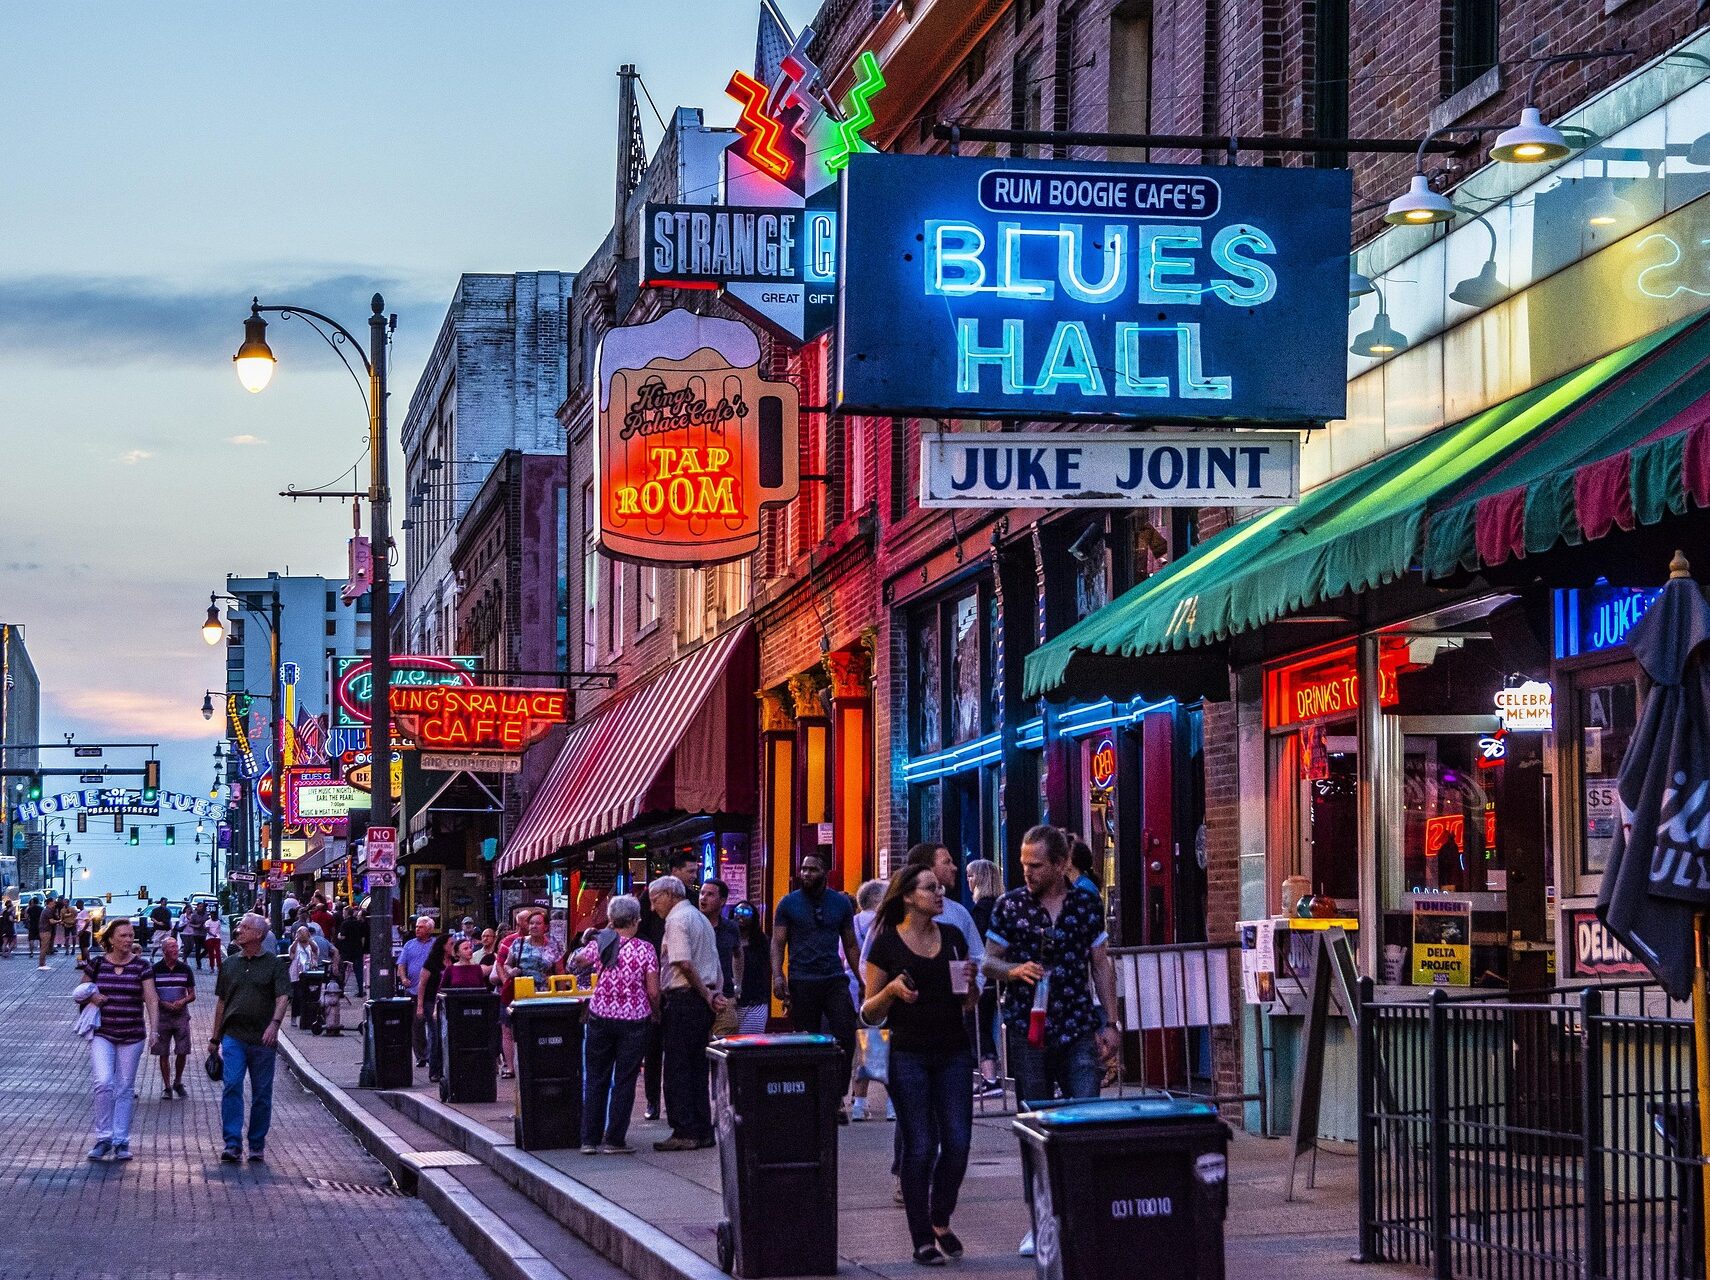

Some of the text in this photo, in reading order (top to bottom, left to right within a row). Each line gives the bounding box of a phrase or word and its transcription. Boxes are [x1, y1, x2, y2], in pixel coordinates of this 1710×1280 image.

[995, 178, 1206, 211] RUM BOOGIE CAFE'S
[654, 211, 795, 277] STRANGE
[924, 219, 1277, 307] BLUES
[761, 292, 800, 304] GREAT
[957, 317, 1233, 400] HALL
[620, 394, 749, 440] Palace Cafe's
[651, 447, 729, 480] TAP
[951, 445, 1270, 491] JUKE JOINT
[617, 476, 739, 515] ROOM
[1296, 681, 1341, 718] DRINKS
[424, 719, 522, 743] CAFE
[446, 757, 518, 769] CONDITIOND
[1093, 749, 1114, 779] OPEN
[18, 789, 99, 822] HOME
[108, 796, 130, 806] THE
[111, 788, 126, 797] OF
[1588, 790, 1613, 808] $5
[92, 806, 154, 814] BEALE STREET
[373, 831, 390, 840] NO
[1421, 959, 1461, 971] PROJECT
[1427, 947, 1456, 958] DELTA
[1112, 1199, 1133, 1217] 031
